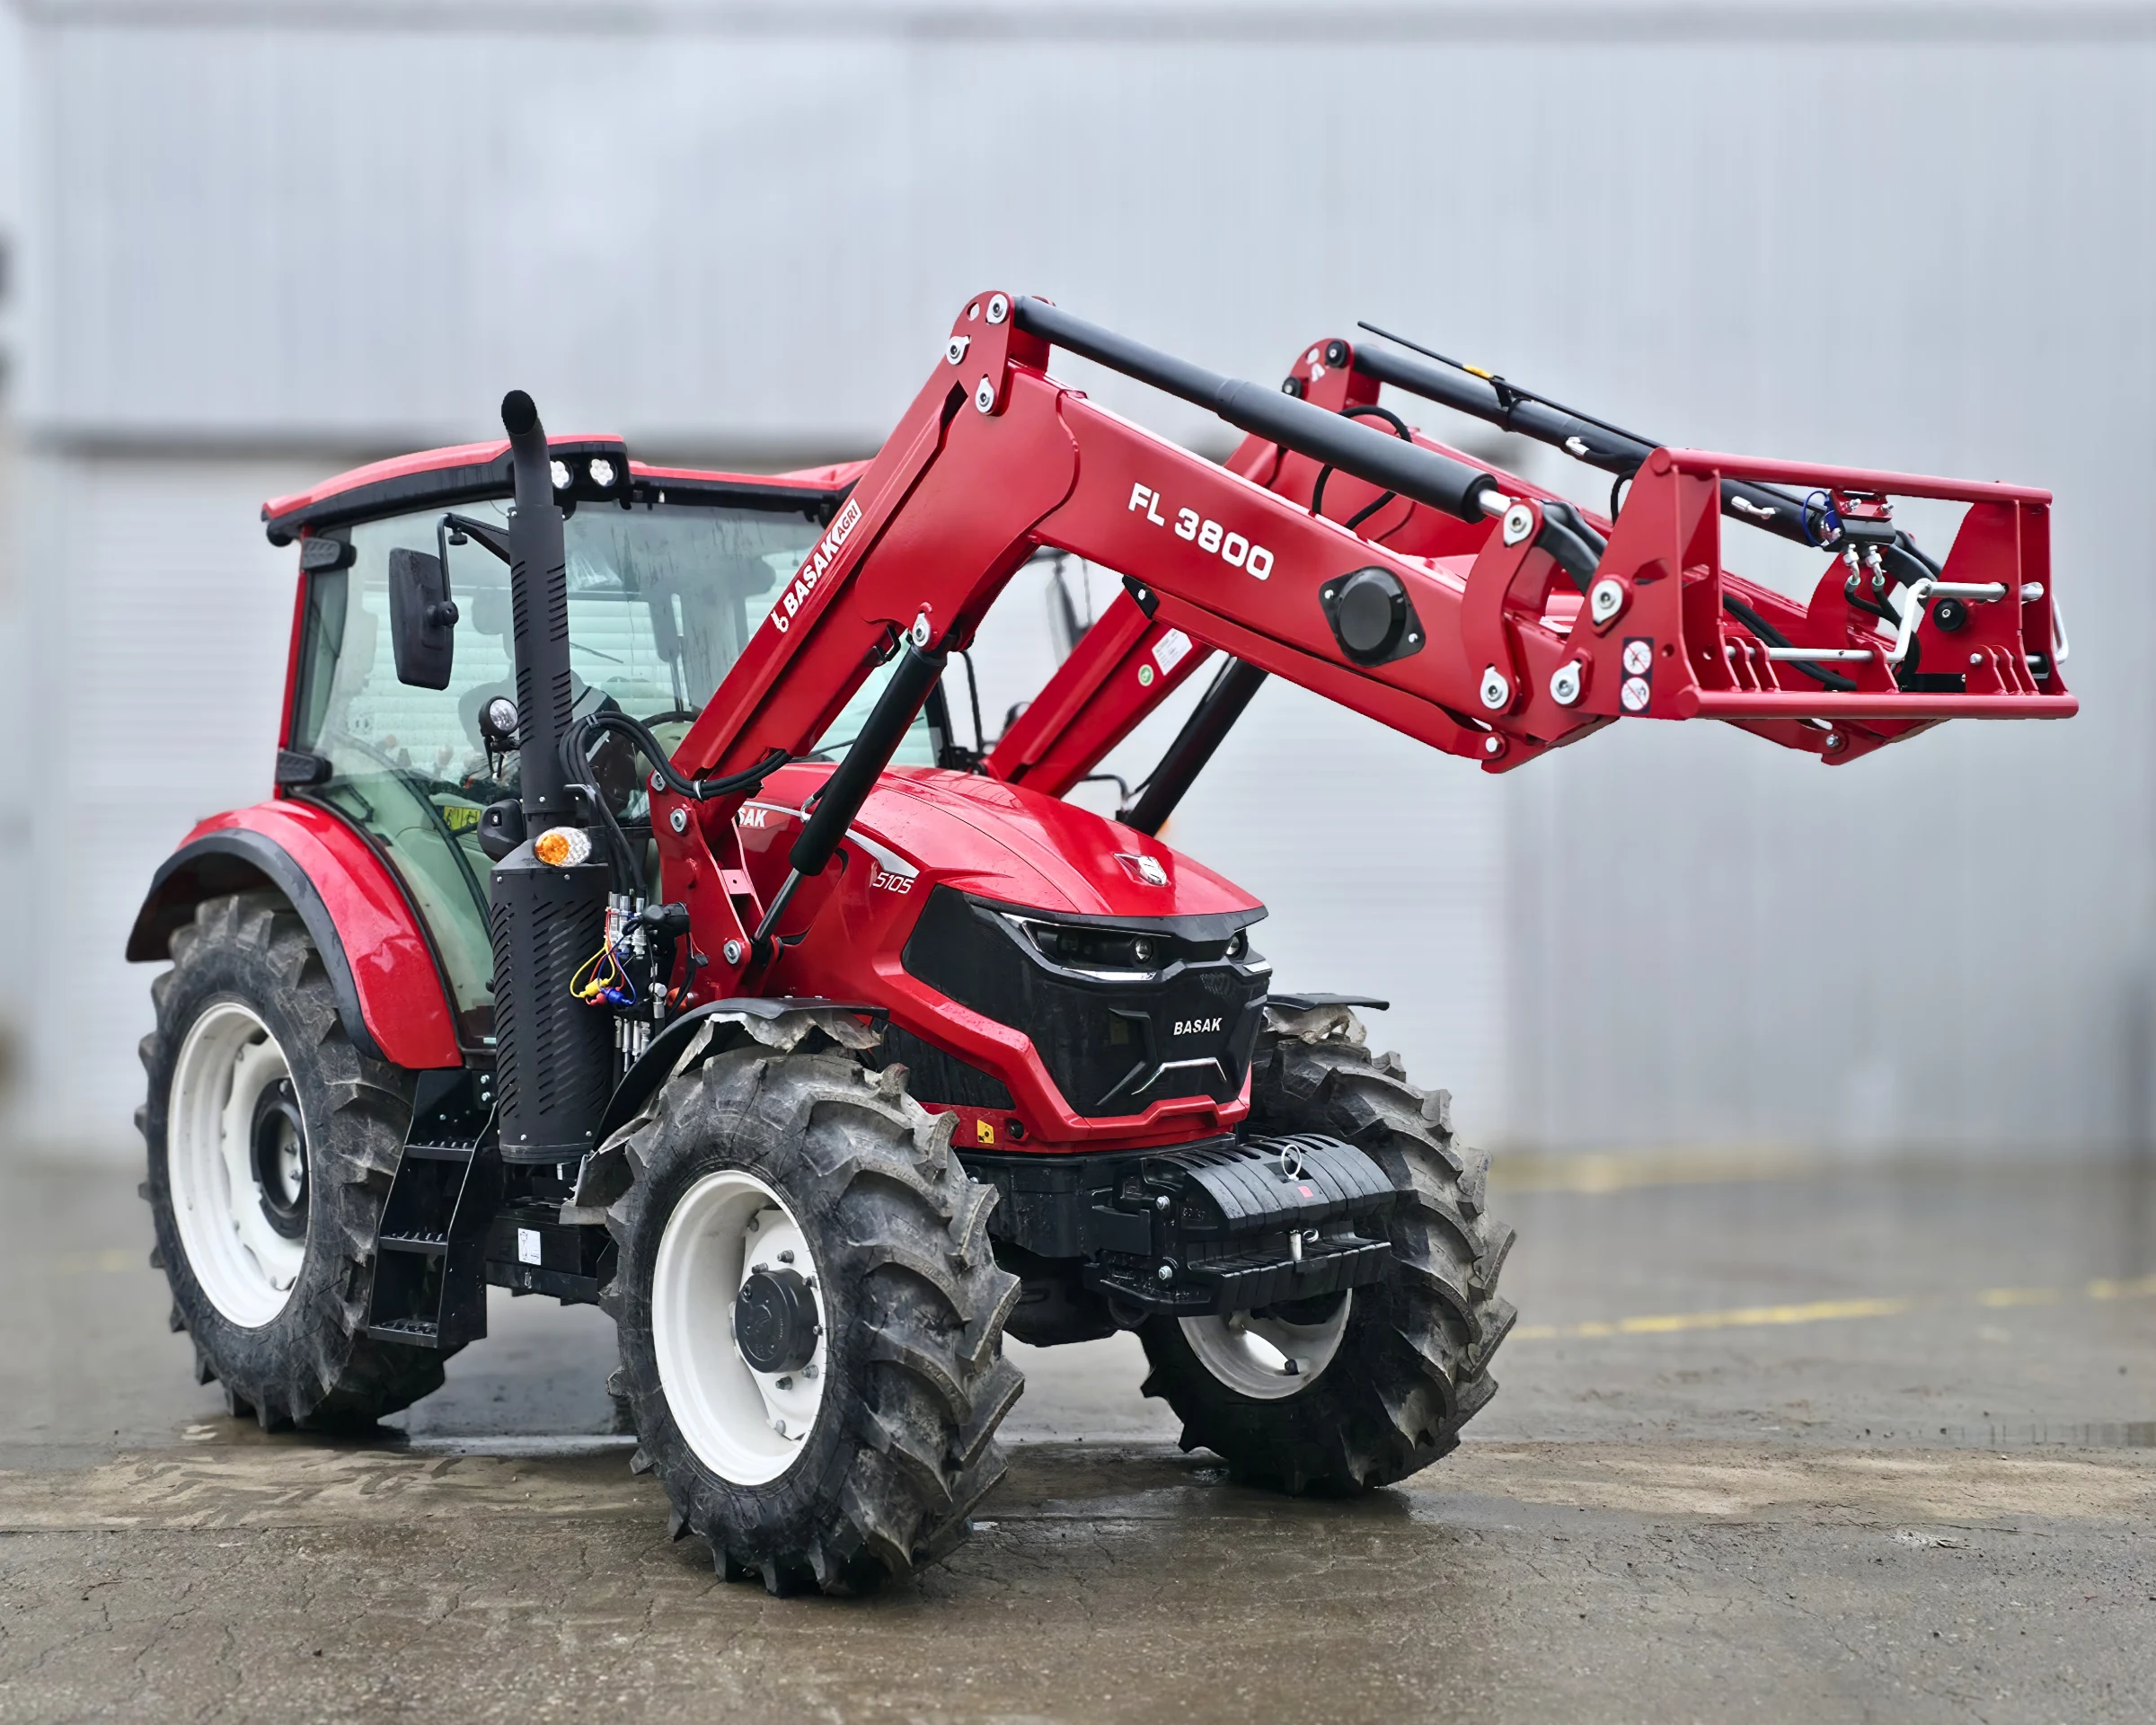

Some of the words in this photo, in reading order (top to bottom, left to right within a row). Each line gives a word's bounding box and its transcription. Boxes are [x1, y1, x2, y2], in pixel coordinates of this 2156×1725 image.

[782, 530, 840, 618] BASAK
[836, 504, 859, 540] AGRI
[1128, 482, 1165, 526] FL
[1174, 507, 1275, 580] 3800
[871, 871, 915, 895] 5105
[1172, 1017, 1223, 1036] BASAK
